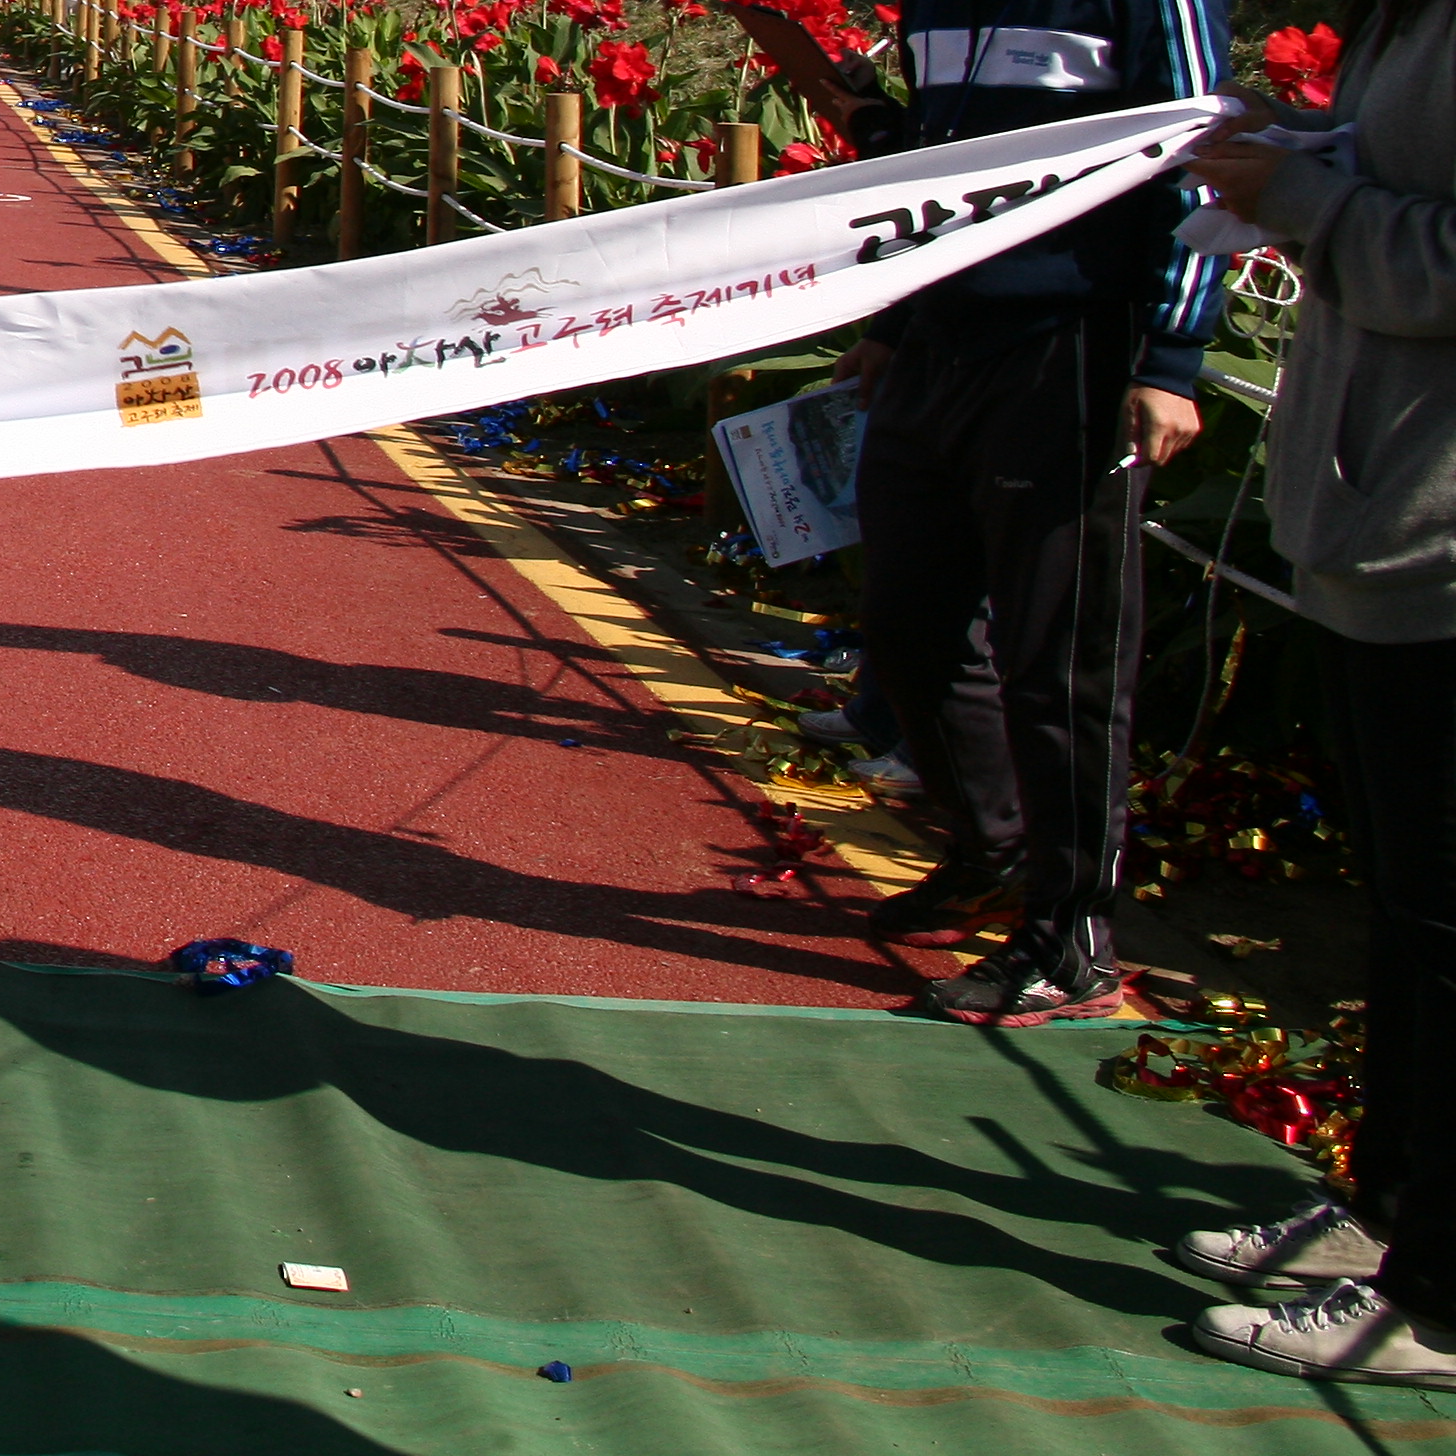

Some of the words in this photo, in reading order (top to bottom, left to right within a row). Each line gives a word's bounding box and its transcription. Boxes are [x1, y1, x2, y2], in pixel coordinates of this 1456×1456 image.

[246, 358, 344, 399] 2008
[352, 330, 507, 377] 아차산
[514, 303, 634, 354] 고구려
[123, 384, 195, 407] 아차산
